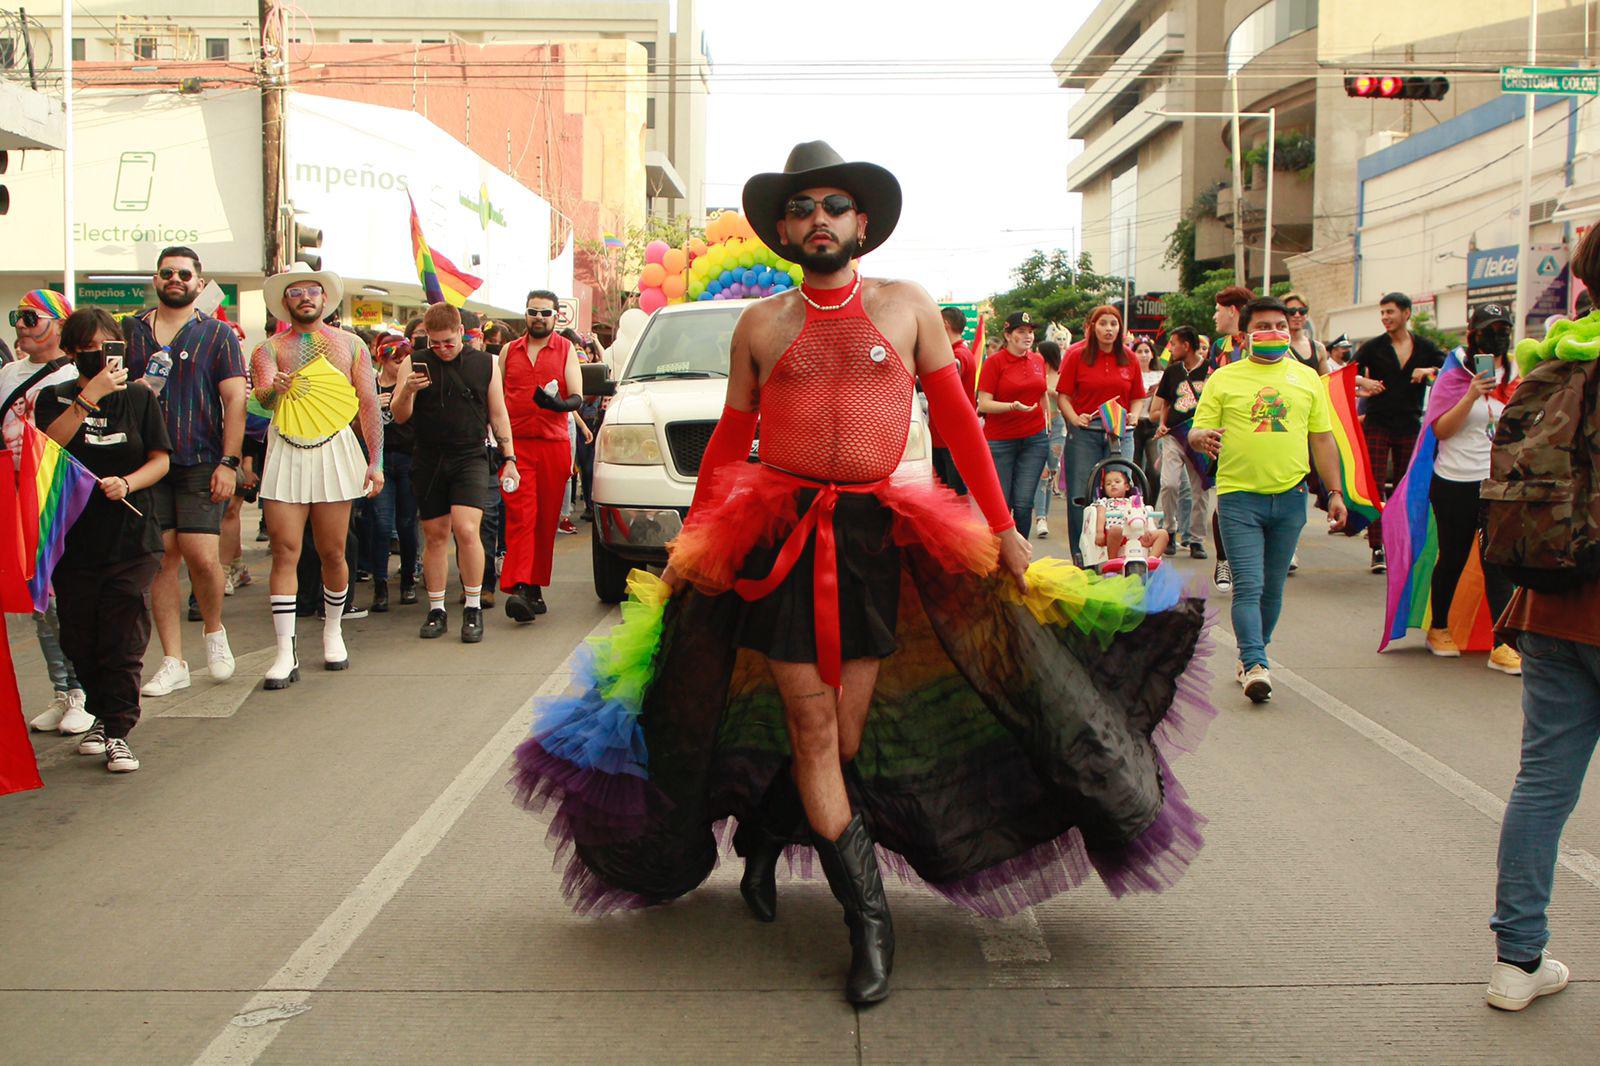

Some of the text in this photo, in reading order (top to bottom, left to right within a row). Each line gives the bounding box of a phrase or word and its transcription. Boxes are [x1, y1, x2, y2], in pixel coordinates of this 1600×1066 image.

[1505, 76, 1597, 91] CRISTOBAL COLON
[290, 163, 408, 193] mpeños
[73, 223, 199, 242] Electrónicos
[78, 287, 126, 299] Empeños
